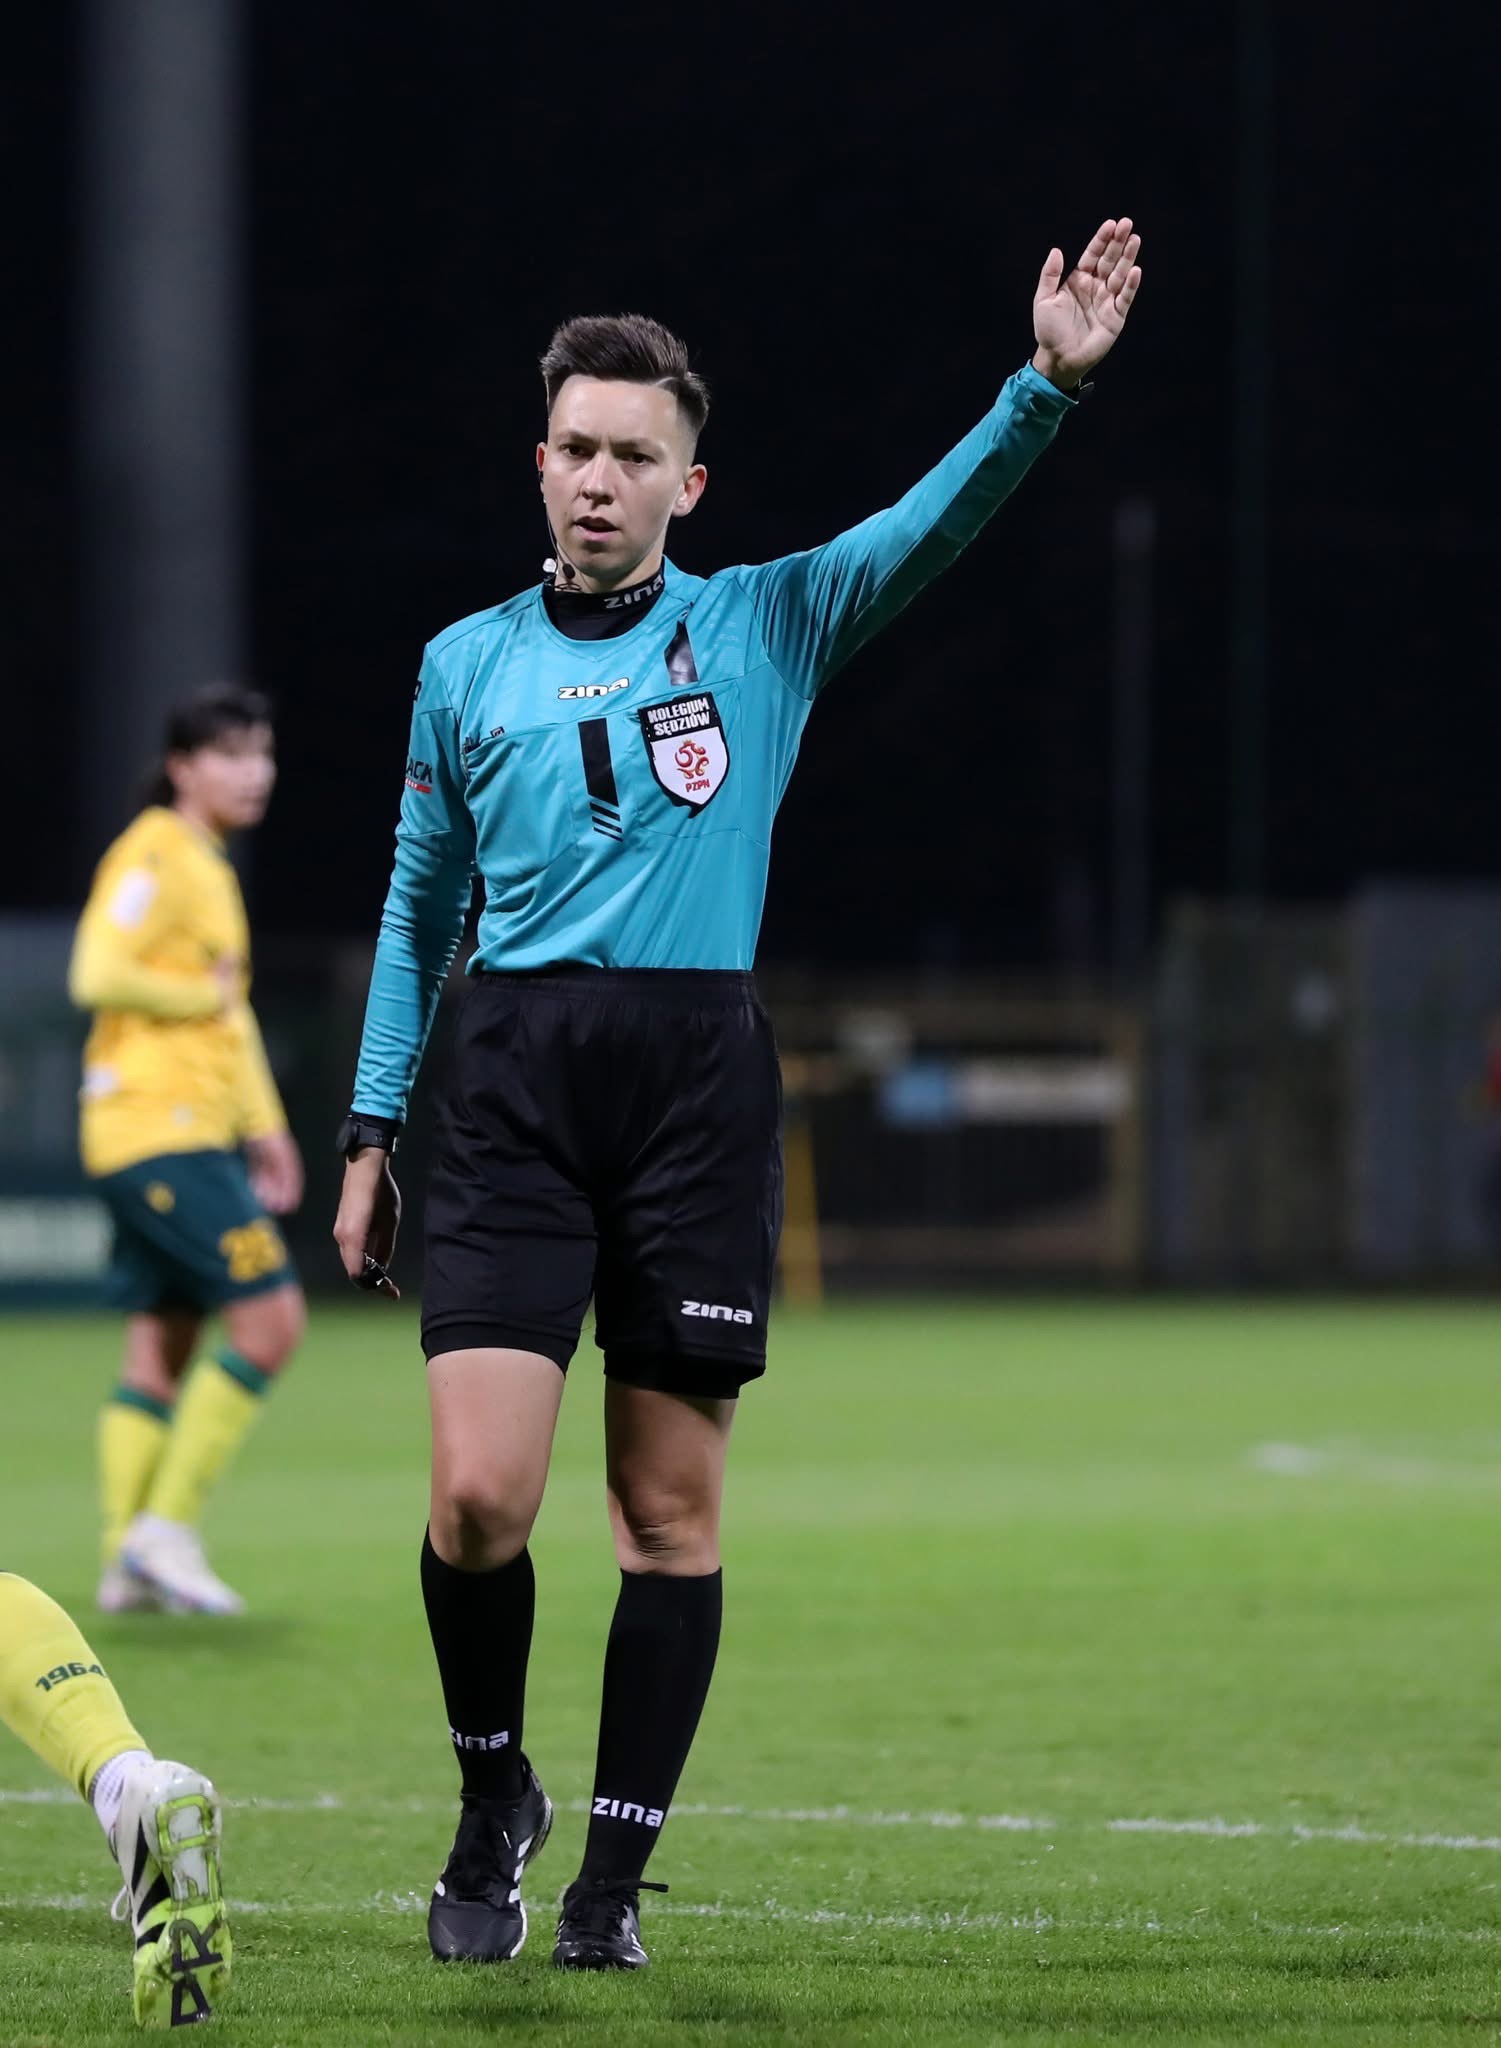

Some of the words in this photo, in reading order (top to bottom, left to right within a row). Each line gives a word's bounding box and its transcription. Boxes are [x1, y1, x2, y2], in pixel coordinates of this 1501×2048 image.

[647, 697, 710, 724] KOLEGIUM
[653, 711, 710, 736] SĘDZIÓW
[685, 778, 711, 792] PZPN
[35, 1662, 106, 1692] 1964
